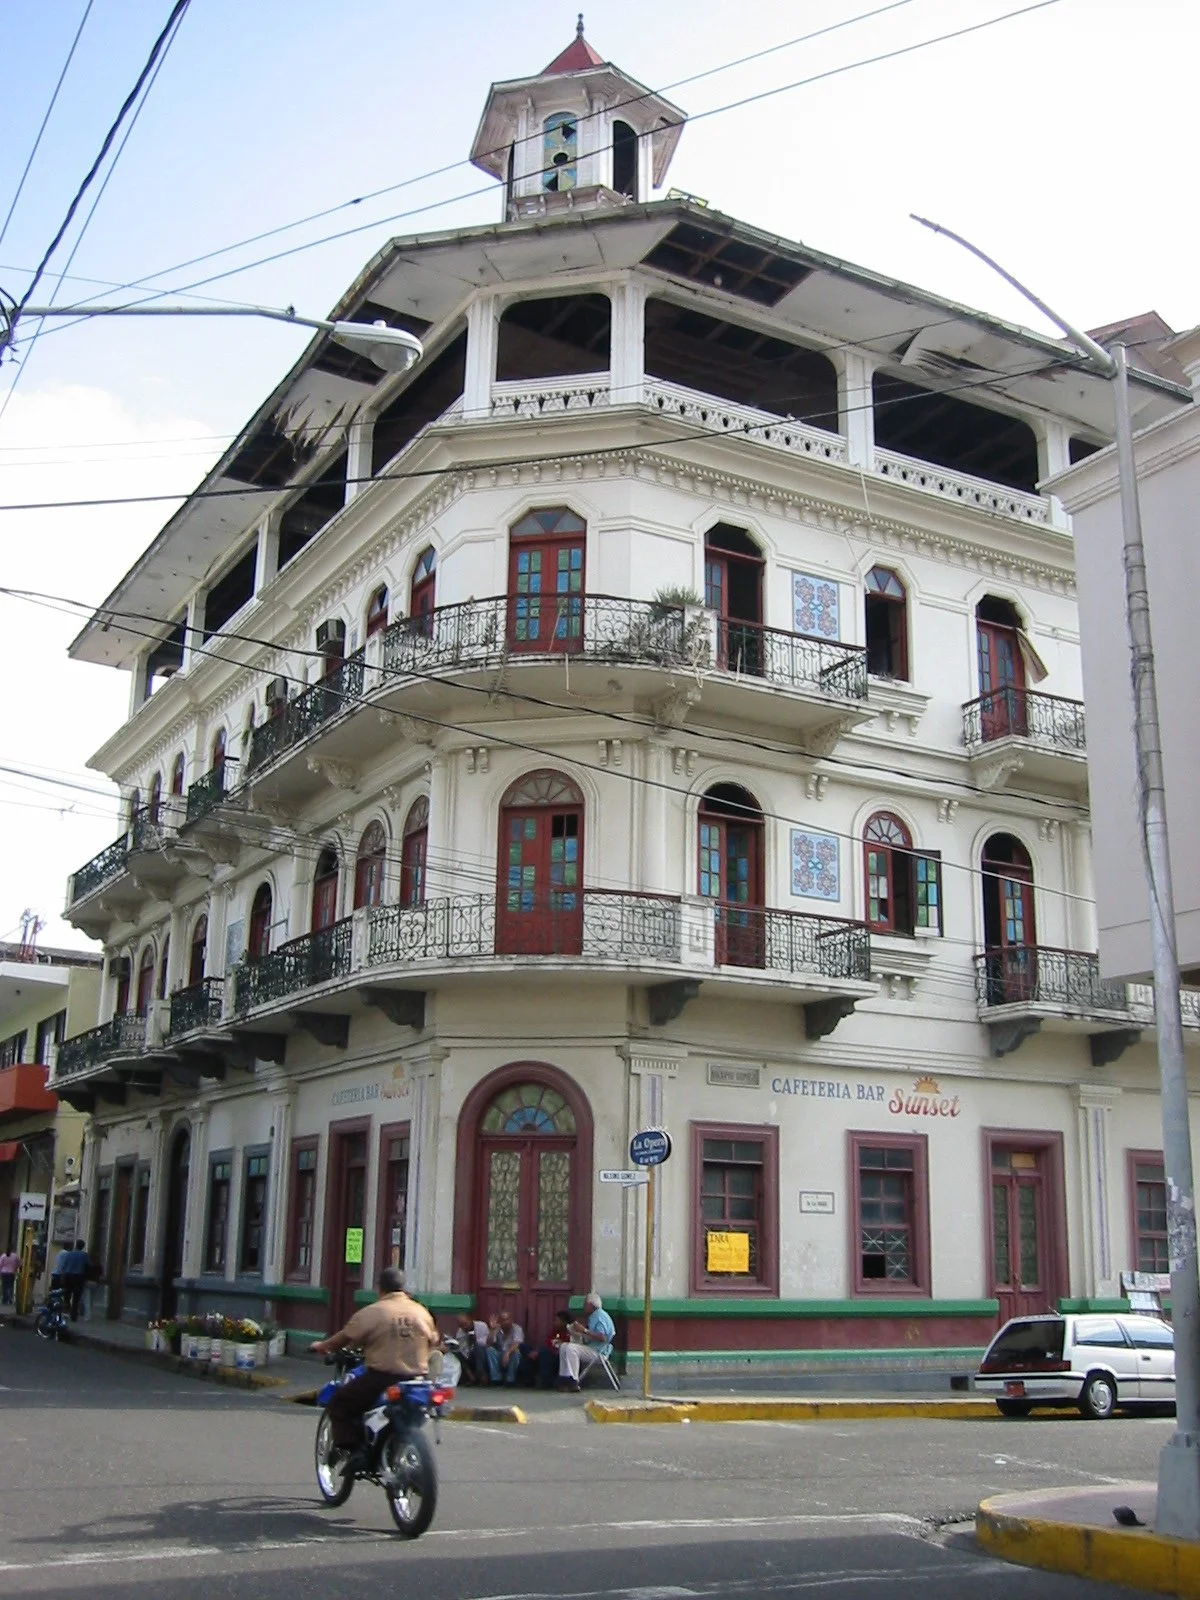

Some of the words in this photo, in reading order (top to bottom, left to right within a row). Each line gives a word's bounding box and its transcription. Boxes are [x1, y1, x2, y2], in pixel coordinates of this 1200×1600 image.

[772, 1078, 851, 1099] CAFETERIA
[856, 1083, 885, 1101] BAR
[888, 1088, 961, 1118] Sunset
